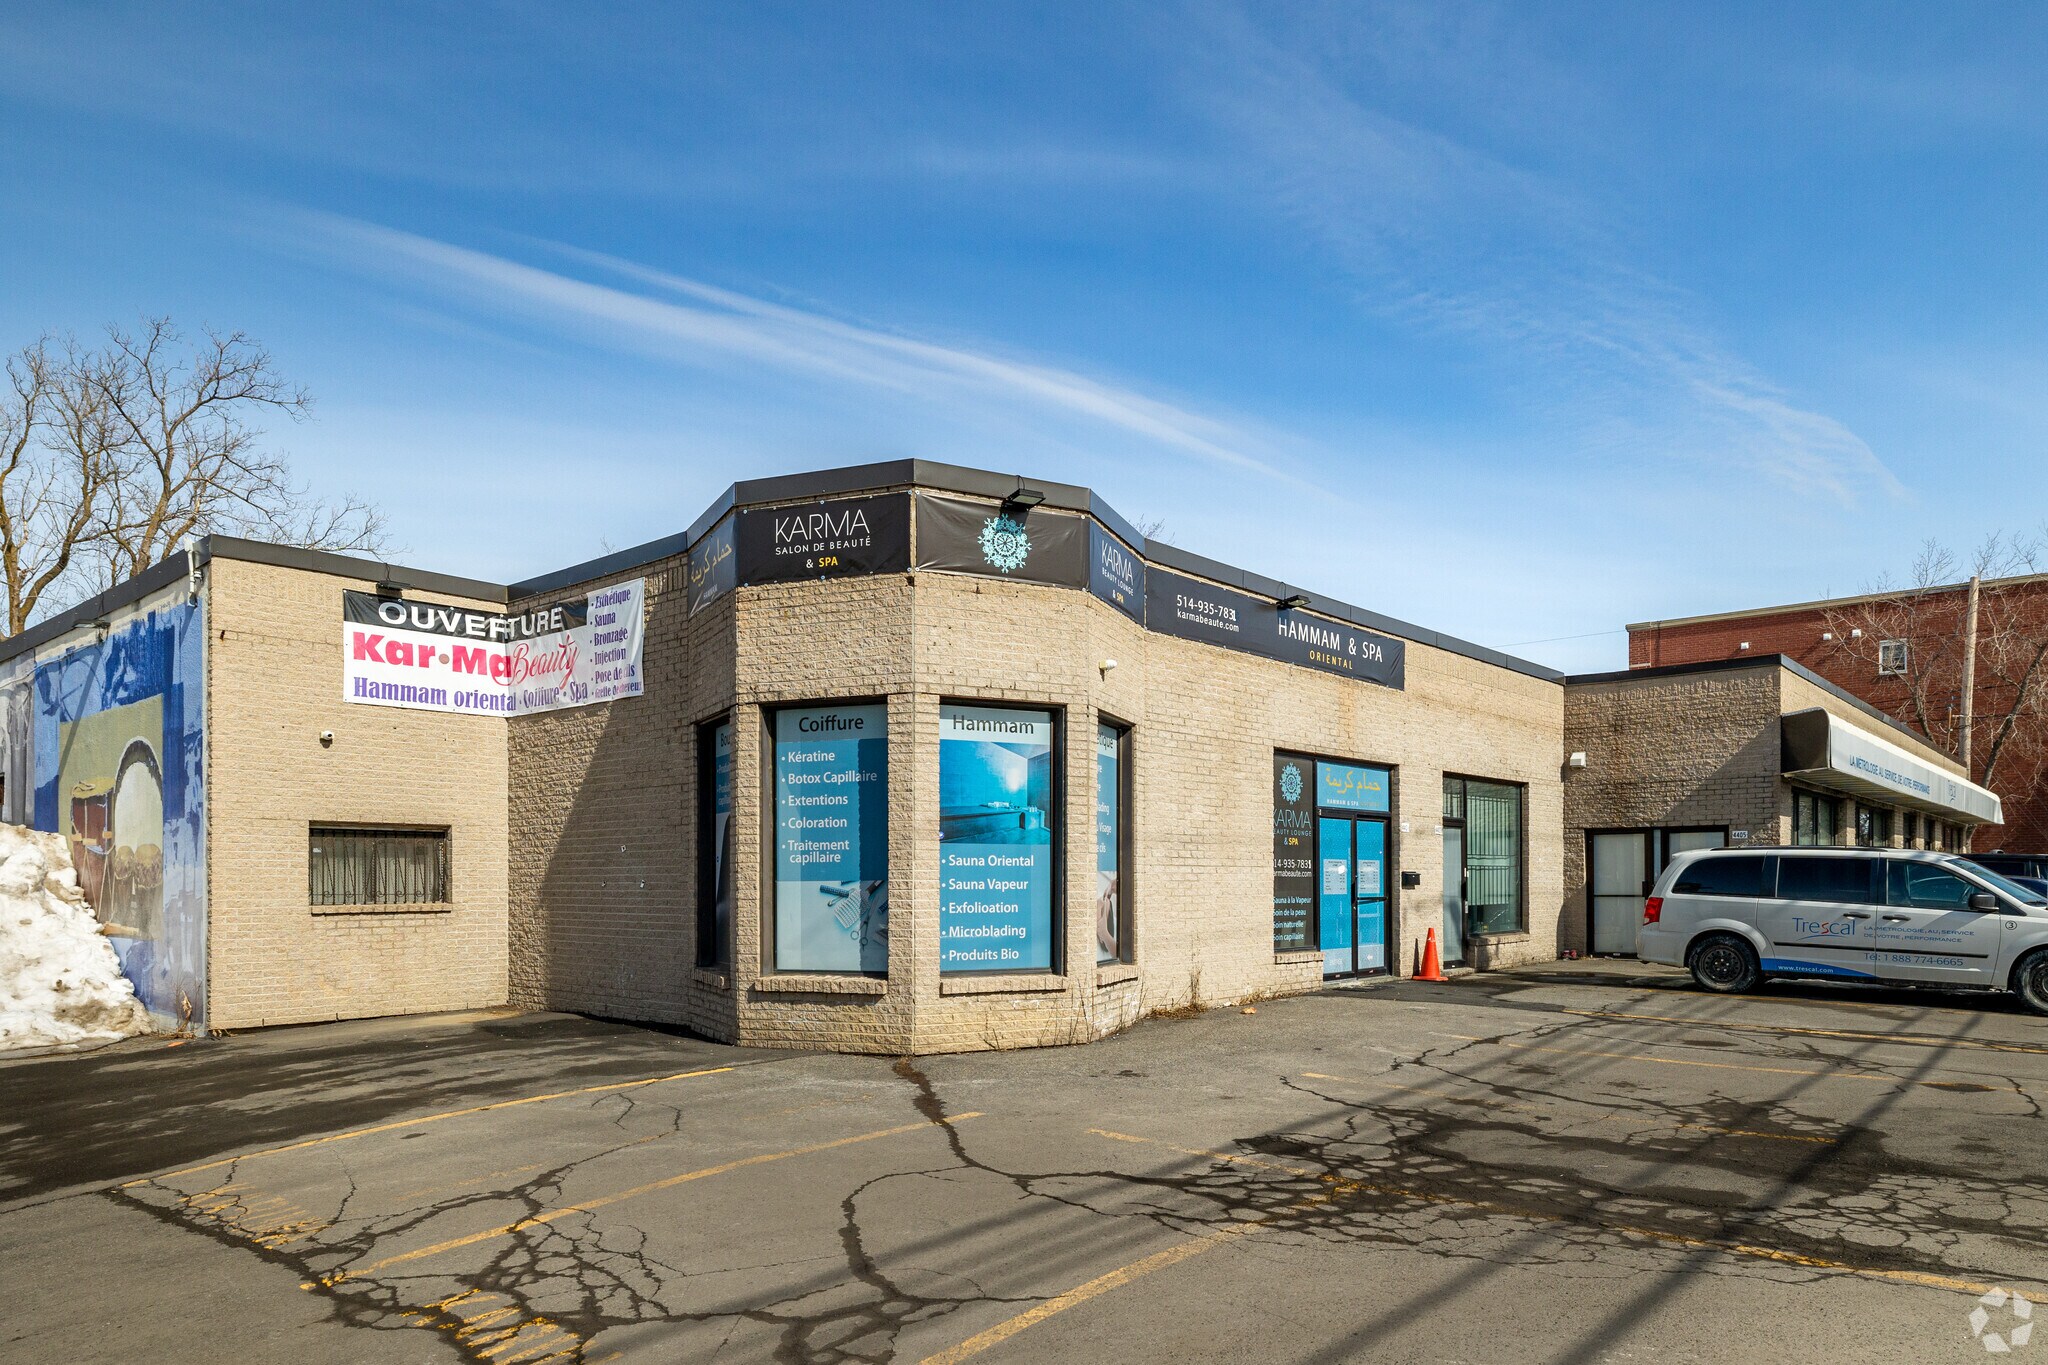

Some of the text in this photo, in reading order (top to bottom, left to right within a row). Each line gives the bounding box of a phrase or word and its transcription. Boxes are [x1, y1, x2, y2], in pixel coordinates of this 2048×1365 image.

[775, 509, 870, 543] KARMA
[775, 537, 871, 556] SALON DE BEAUTÉ
[805, 556, 838, 569] & SPA
[1101, 540, 1133, 585] KARMA
[1102, 567, 1134, 596] BEAUTY LOUNGE
[595, 588, 631, 609] Esthétique
[378, 602, 563, 640] OUVERTURE
[594, 611, 616, 627] Sauna
[1177, 608, 1240, 632] karmabeaute.com
[594, 627, 628, 646] Bronzage
[1278, 618, 1383, 663] HAMMAM & SPA
[511, 632, 579, 690] Beauty
[594, 647, 627, 666] Injection
[1309, 650, 1353, 670] ORIENTAL
[595, 669, 612, 685] Pose
[613, 666, 623, 680] de
[353, 677, 517, 711] Hammam oriental
[570, 681, 588, 703] Spa
[798, 715, 865, 733] Coiffure
[952, 714, 1034, 734] Hammam
[788, 750, 836, 764] Kératine
[788, 770, 878, 785] Botox Capillaire
[1884, 769, 1897, 783] SERVICE
[788, 794, 849, 807] Extentions
[788, 816, 848, 829] Coloration
[788, 839, 850, 851] Traitement
[1284, 837, 1299, 846] & SPA
[789, 851, 841, 866] capillaire
[949, 854, 1034, 867] Sauna Oriental
[949, 878, 1028, 894] Sauna Vapeur
[949, 902, 1019, 914] Exfolioation
[1284, 908, 1290, 916] de
[1295, 909, 1307, 917] peau
[949, 925, 1027, 939] Microblading
[1792, 917, 1855, 936] Trescal
[1904, 935, 1962, 943] PERFORMANCE
[949, 947, 1019, 961] Produits Bio
[1884, 953, 1889, 961] 1
[1892, 954, 1911, 963] 888
[1915, 956, 1964, 966] 774-6665
[1778, 965, 1834, 974] www.trescal.com
